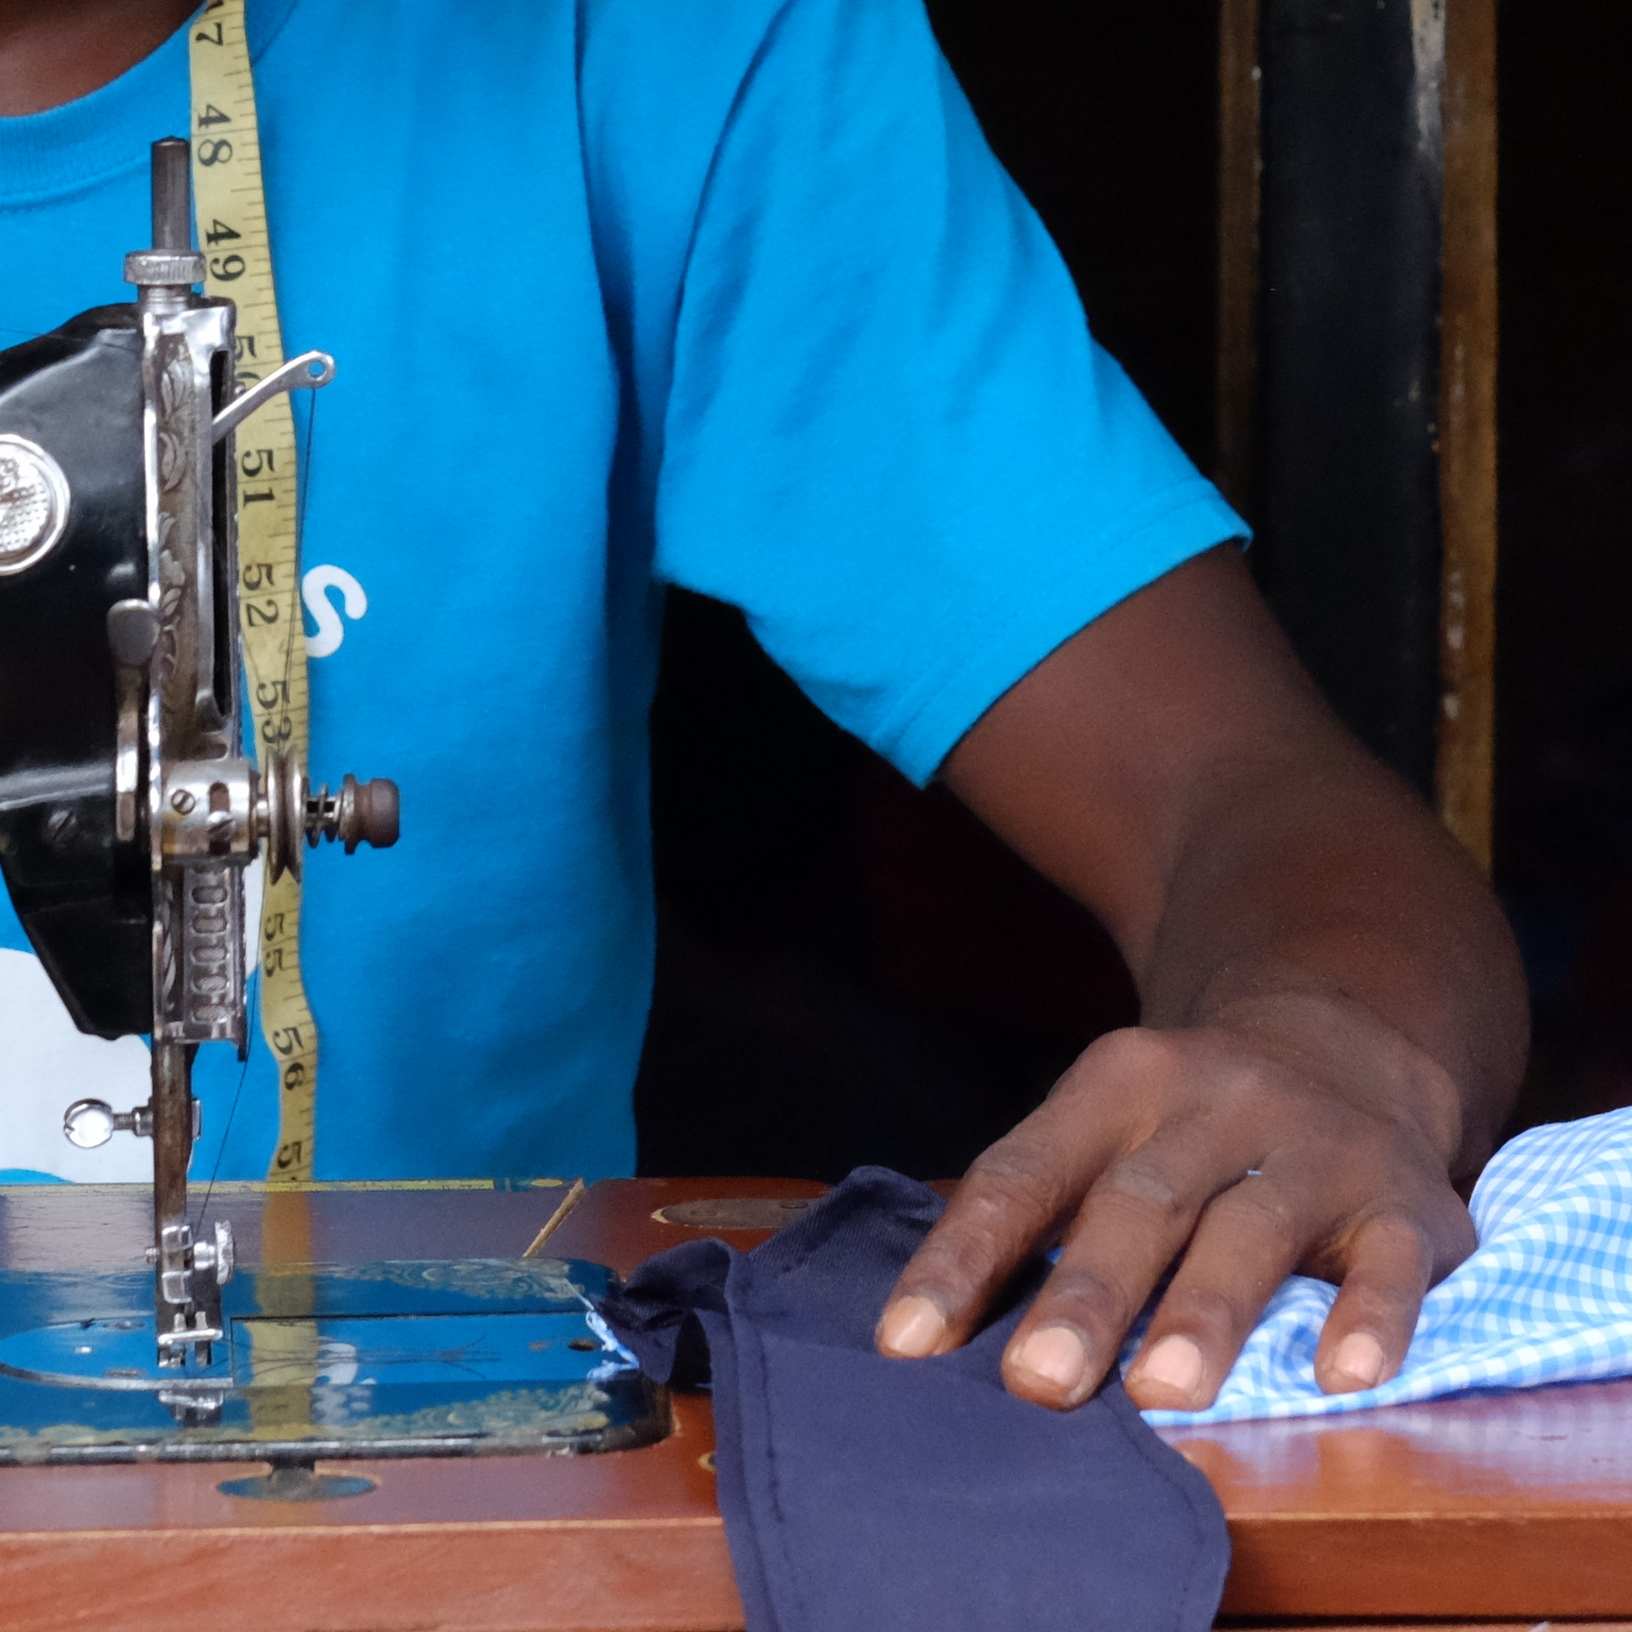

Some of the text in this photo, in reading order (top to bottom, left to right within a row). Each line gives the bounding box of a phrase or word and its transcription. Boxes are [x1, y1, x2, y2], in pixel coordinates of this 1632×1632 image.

[198, 102, 234, 168] 48
[205, 218, 247, 283] 49
[241, 447, 276, 509] 51
[243, 561, 280, 629] 52
[256, 679, 294, 745] 53
[263, 913, 287, 977] 55
[271, 1026, 307, 1092] 56
